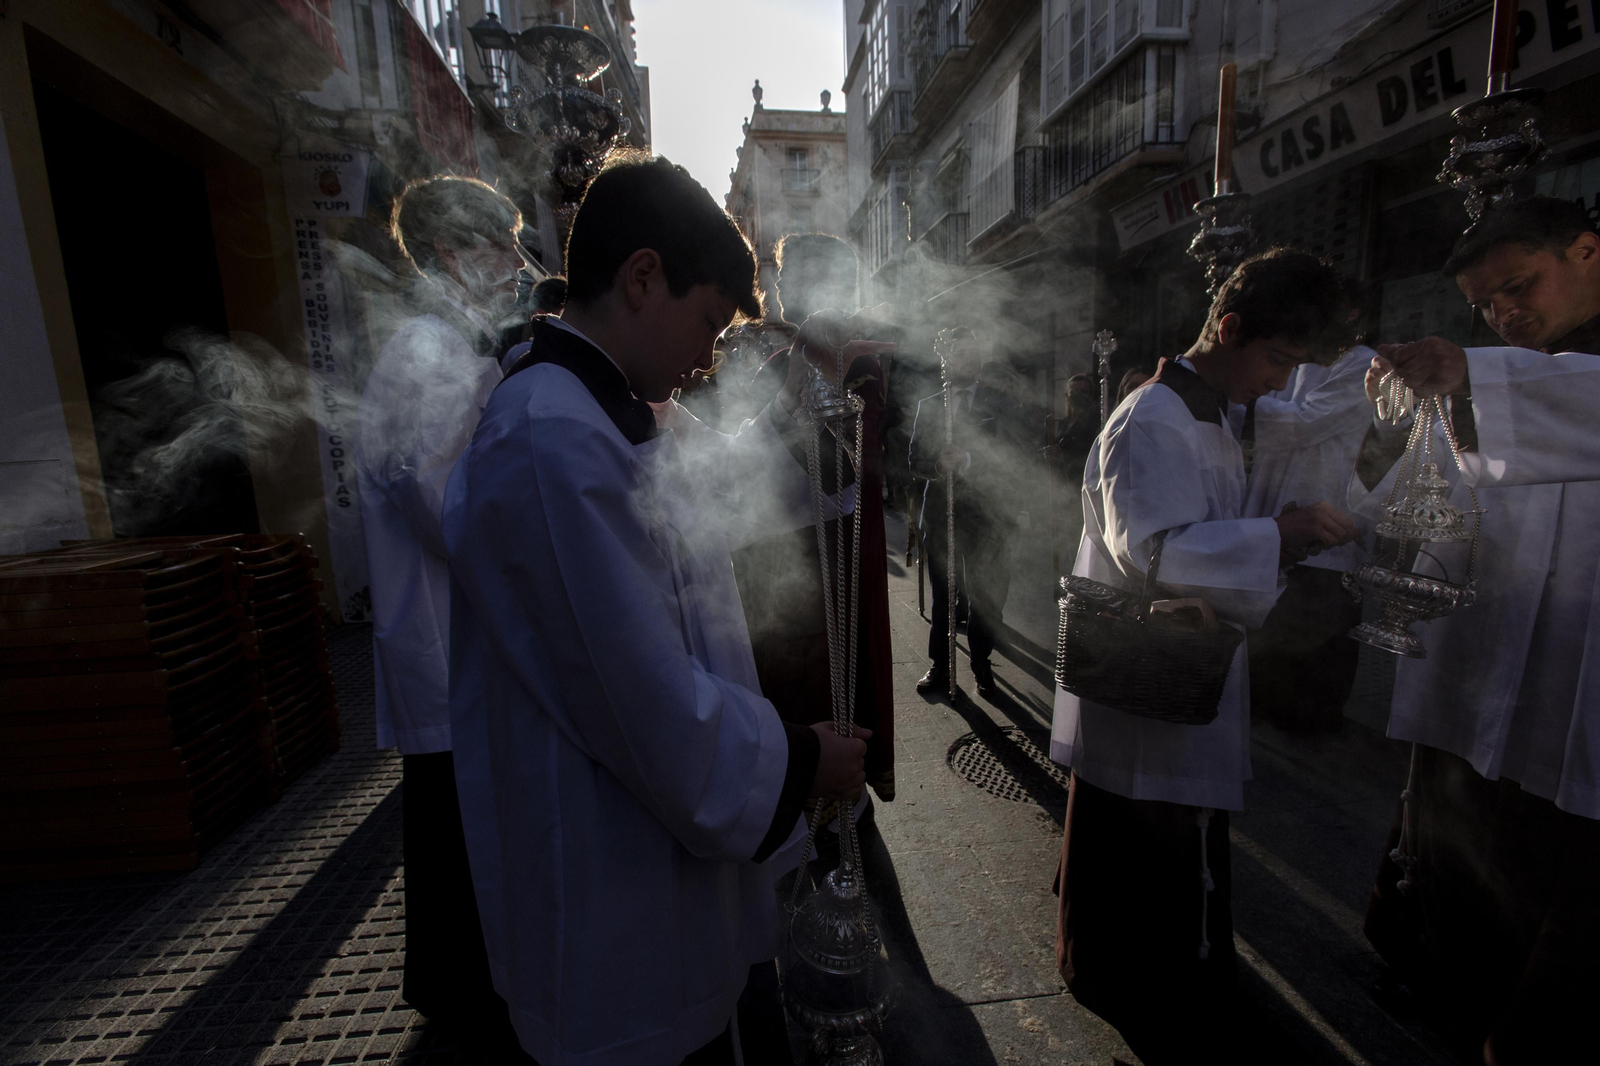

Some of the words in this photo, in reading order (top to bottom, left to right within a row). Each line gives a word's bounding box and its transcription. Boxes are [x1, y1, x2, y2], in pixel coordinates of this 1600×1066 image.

[299, 151, 353, 163] KIOSKO
[1259, 101, 1357, 179] CASA
[1376, 46, 1466, 128] DEL
[1508, 0, 1600, 70] PE
[312, 200, 350, 212] YUPI
[294, 218, 313, 281] PRENSA
[305, 298, 323, 369] BEBIDAS
[307, 219, 322, 271] PRESS
[315, 282, 336, 373] SOUVENIRS
